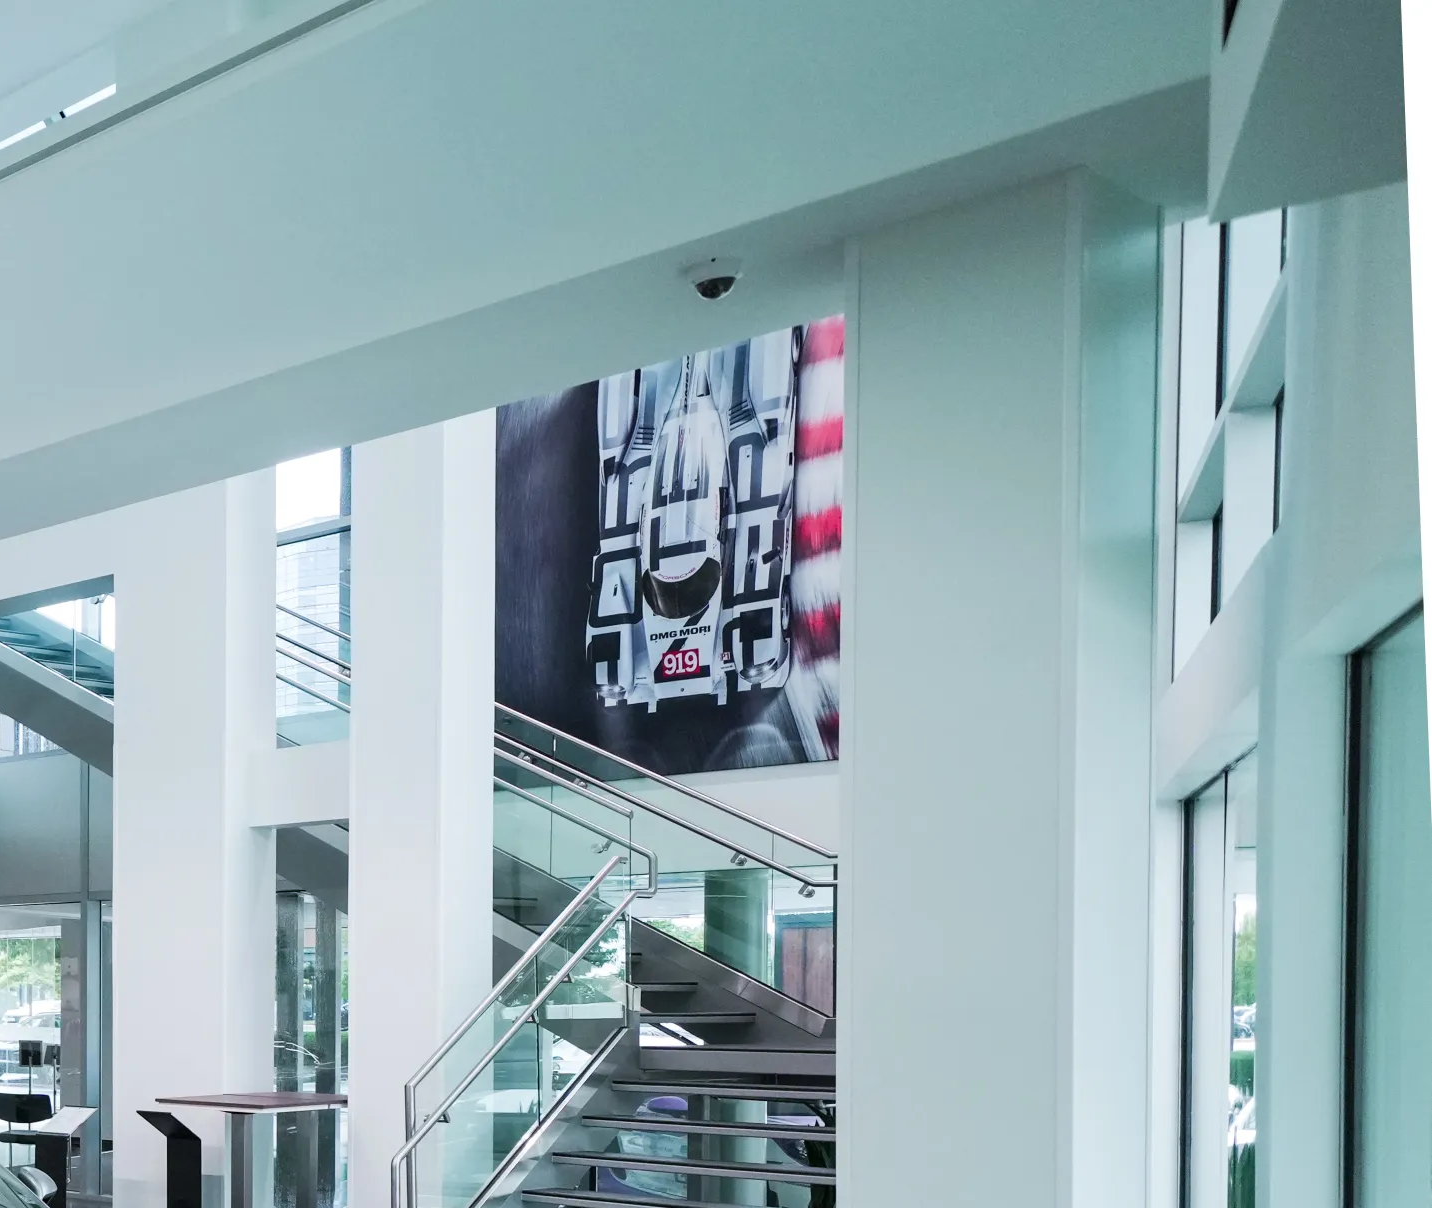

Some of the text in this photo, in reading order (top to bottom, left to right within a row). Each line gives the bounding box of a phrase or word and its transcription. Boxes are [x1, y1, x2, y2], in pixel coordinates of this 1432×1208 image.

[650, 625, 711, 641] DMG MORI
[663, 651, 698, 675] 919
